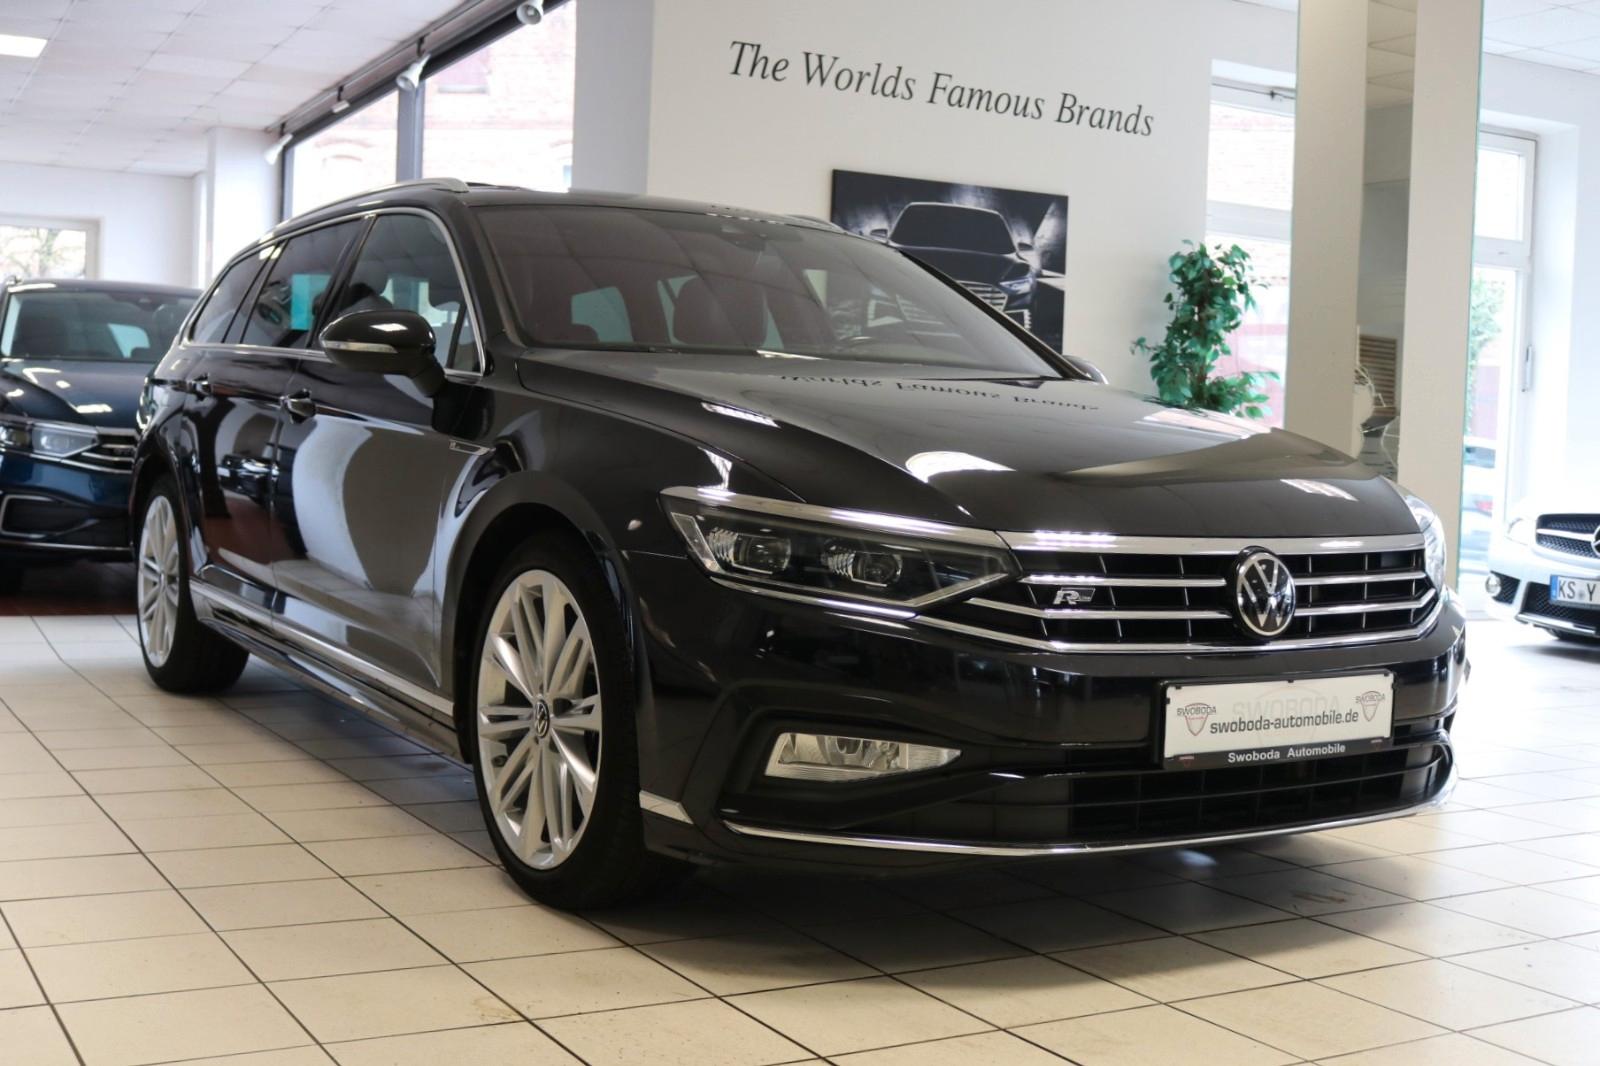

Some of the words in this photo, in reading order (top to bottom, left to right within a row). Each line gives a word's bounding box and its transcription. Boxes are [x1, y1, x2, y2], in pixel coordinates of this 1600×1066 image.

[730, 41, 790, 82] The
[802, 52, 916, 101] Worlds
[927, 72, 1045, 119] Famous
[1054, 92, 1154, 136] Brands
[1559, 581, 1576, 598] KS
[1587, 583, 1596, 601] Y
[1176, 706, 1216, 716] SWOBODA
[1210, 709, 1359, 734] swoboda-automobile.de
[1228, 751, 1280, 763] Swoboda
[1287, 743, 1346, 758] Automobile
